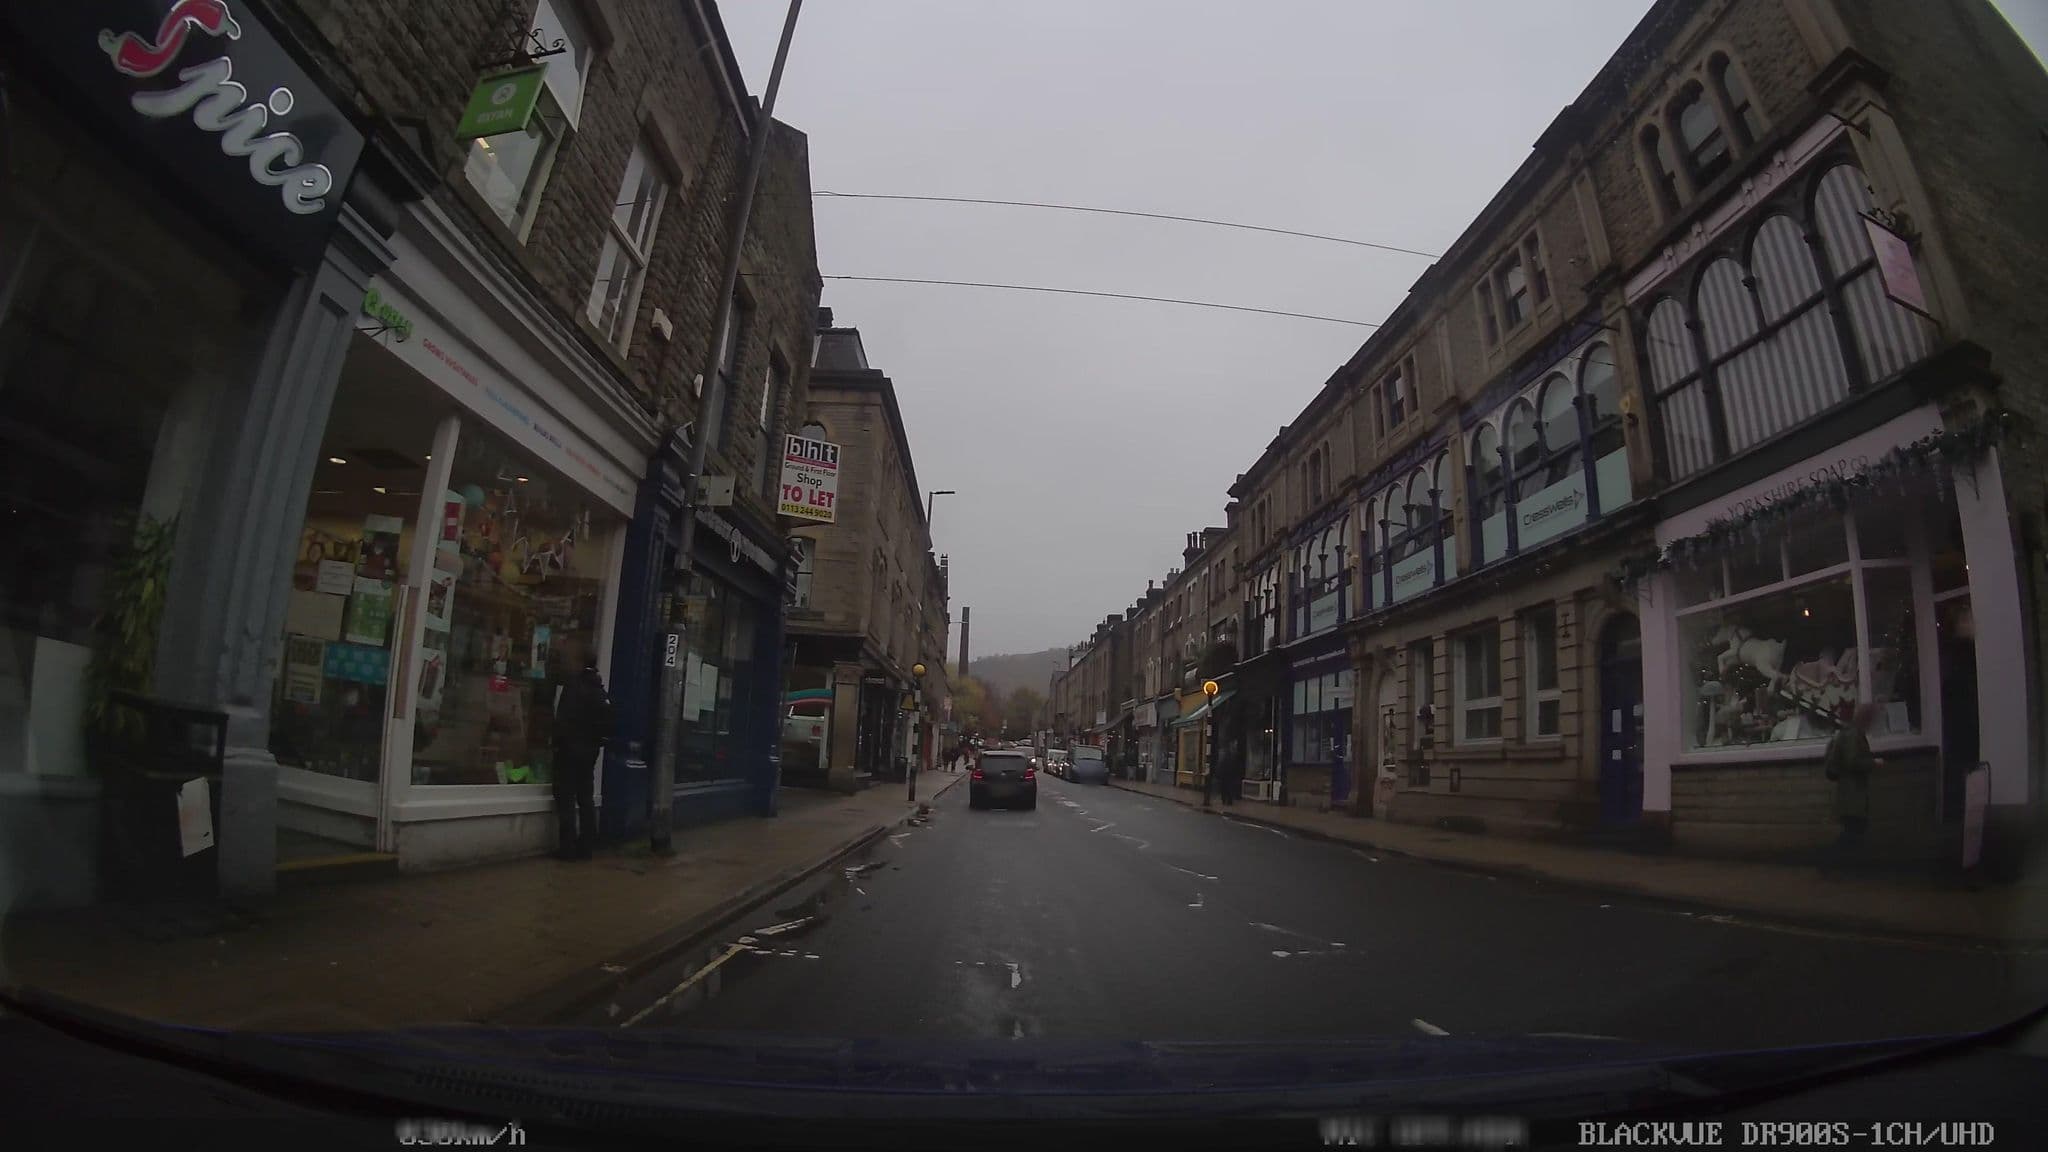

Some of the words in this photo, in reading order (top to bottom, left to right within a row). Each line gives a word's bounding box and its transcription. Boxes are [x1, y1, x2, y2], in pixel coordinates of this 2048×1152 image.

[789, 437, 834, 463] bht
[797, 473, 823, 489] Shop
[783, 484, 803, 502] TO
[808, 489, 835, 508] LET
[667, 636, 677, 664] 204
